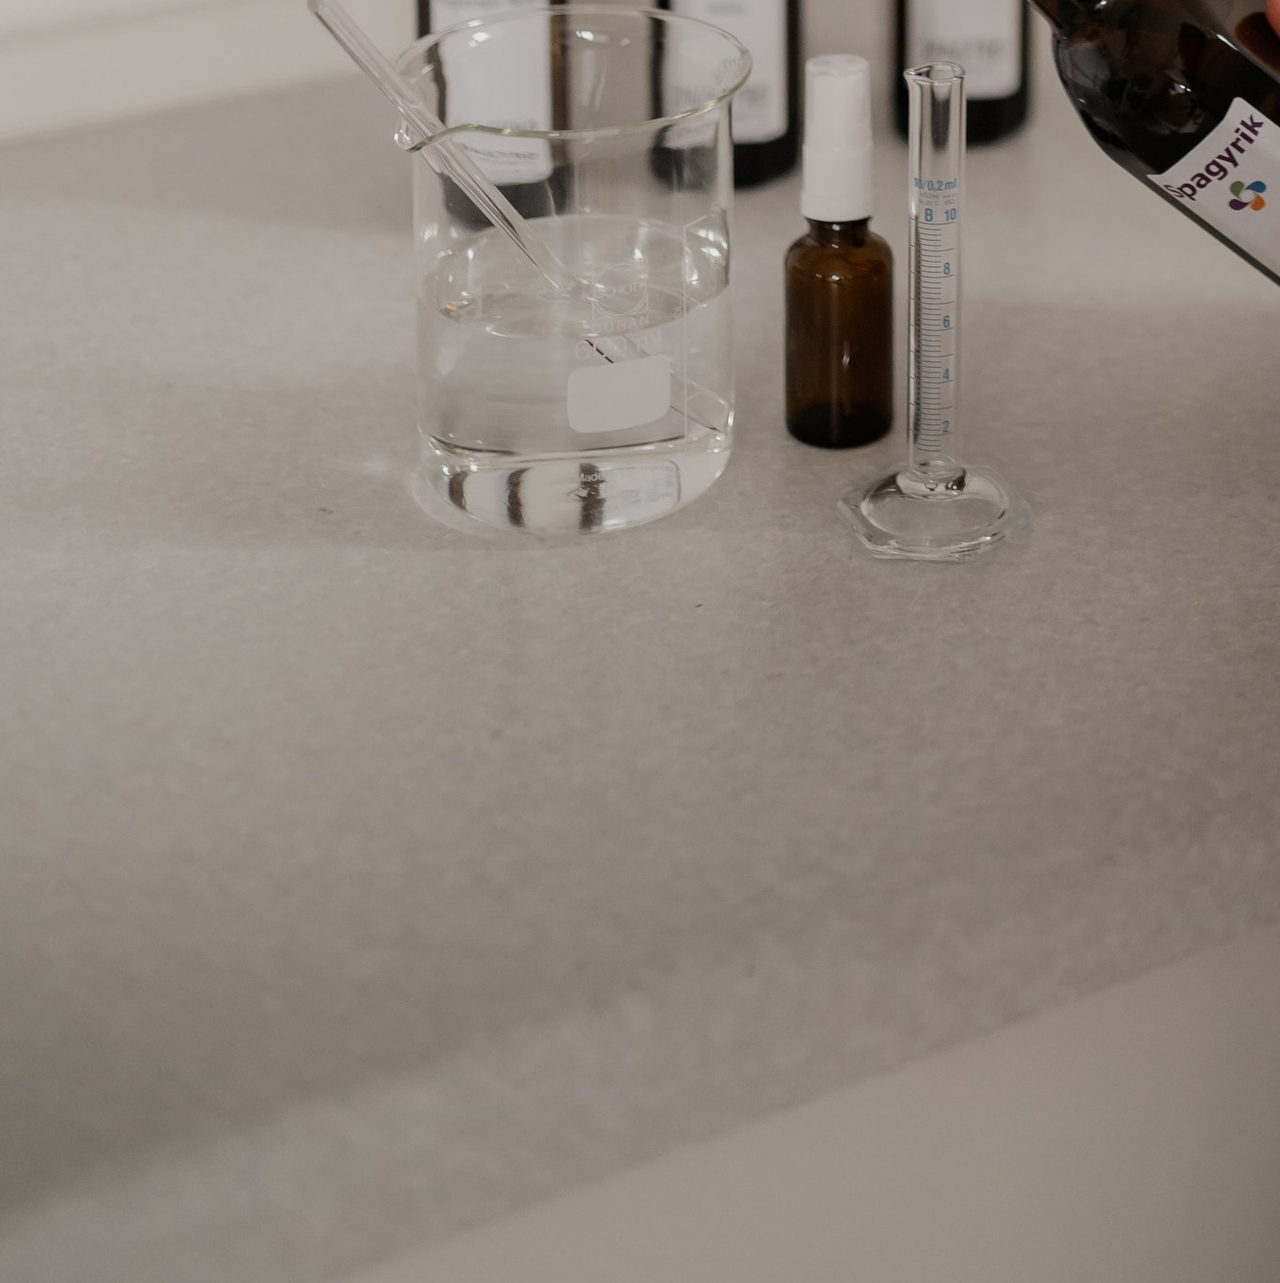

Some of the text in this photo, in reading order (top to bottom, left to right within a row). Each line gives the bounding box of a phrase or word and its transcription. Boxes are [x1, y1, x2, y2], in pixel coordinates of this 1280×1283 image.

[1164, 115, 1264, 202] Spagyrik
[925, 208, 957, 222] B 10
[943, 262, 951, 275] 8
[942, 314, 951, 328] 6
[942, 368, 950, 381] 4
[942, 420, 950, 433] 2
